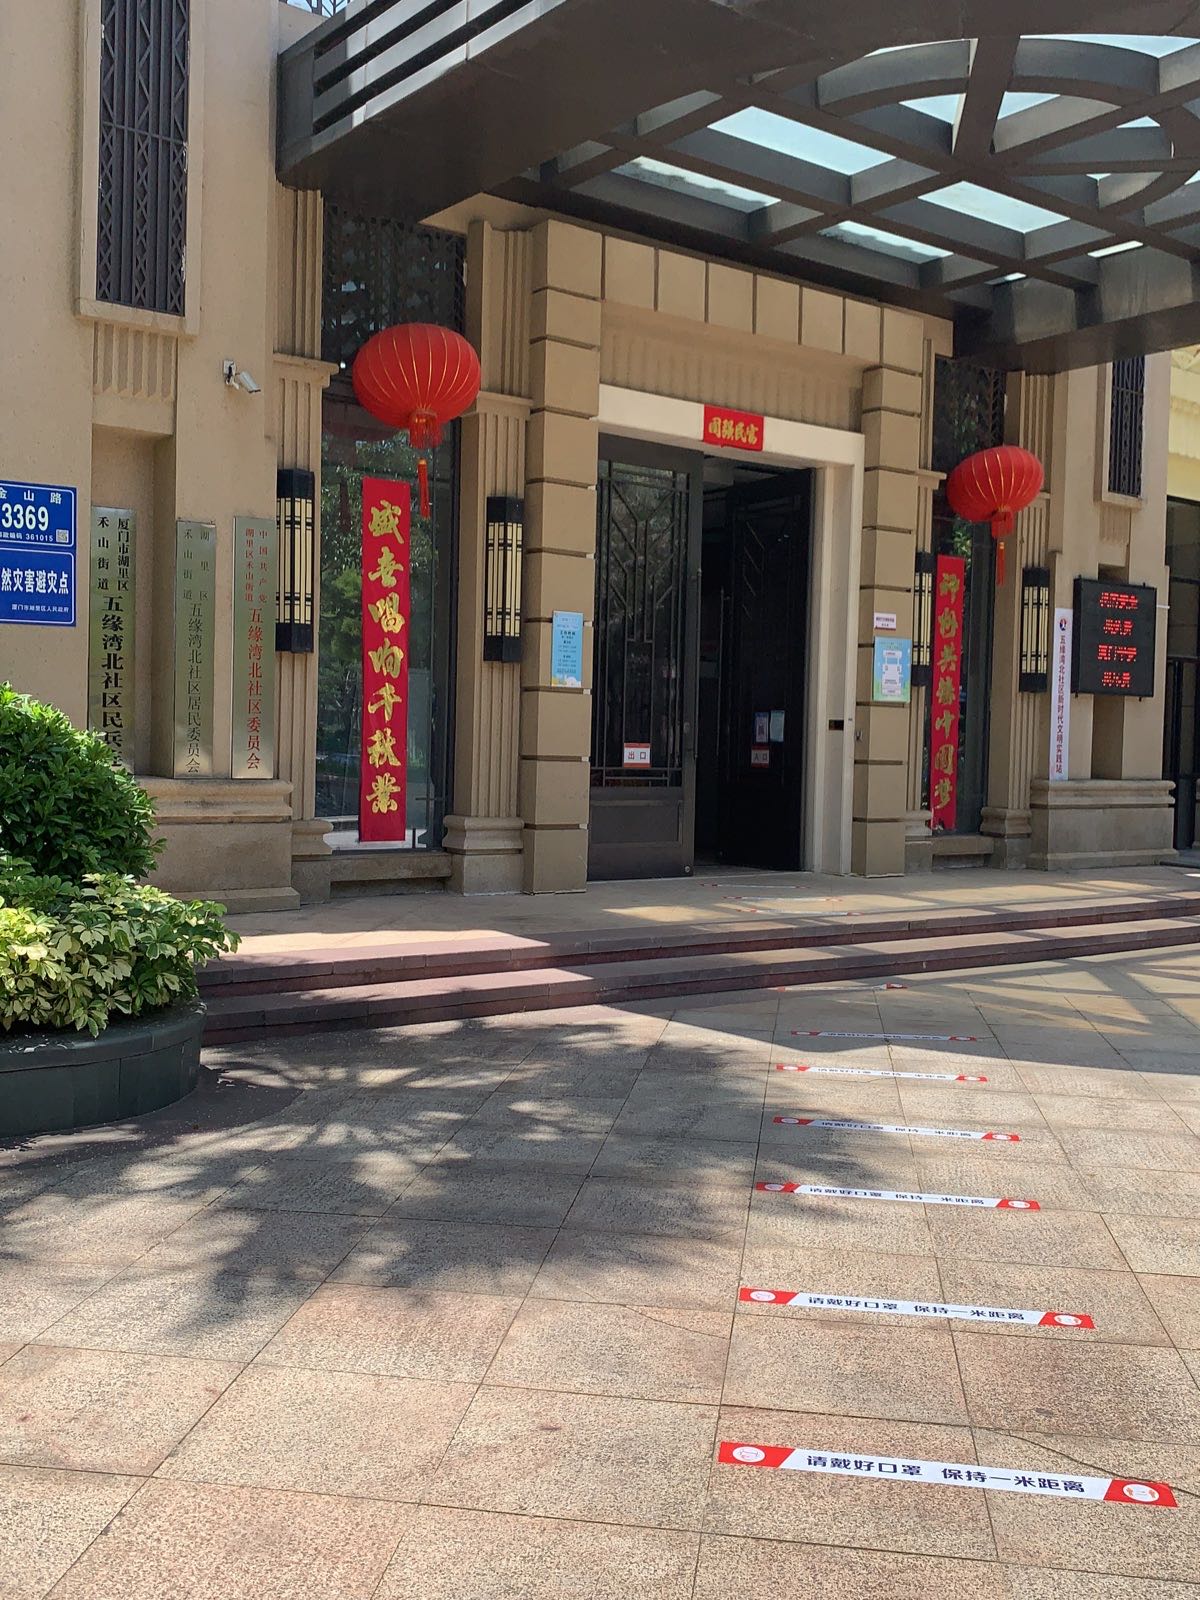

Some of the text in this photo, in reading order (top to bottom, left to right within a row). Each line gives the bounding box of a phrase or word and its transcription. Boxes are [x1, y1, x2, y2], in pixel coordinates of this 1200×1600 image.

[0, 487, 62, 505] 金山路
[1, 503, 49, 531] 3369
[25, 533, 54, 542] 361015
[97, 515, 110, 590] 禾山街道
[117, 518, 130, 591] 厦门市湖里区
[1, 567, 69, 595] 然灾害避灾点
[186, 603, 203, 773] 五缘湾北社区居民委员会
[246, 607, 263, 770] 五缘湾北社区委员会
[627, 751, 647, 760] 出口
[808, 1296, 1025, 1321] 请戴好口罩 保持一米距离
[806, 1455, 1086, 1494] 请戴好口罩 保持一米距离
